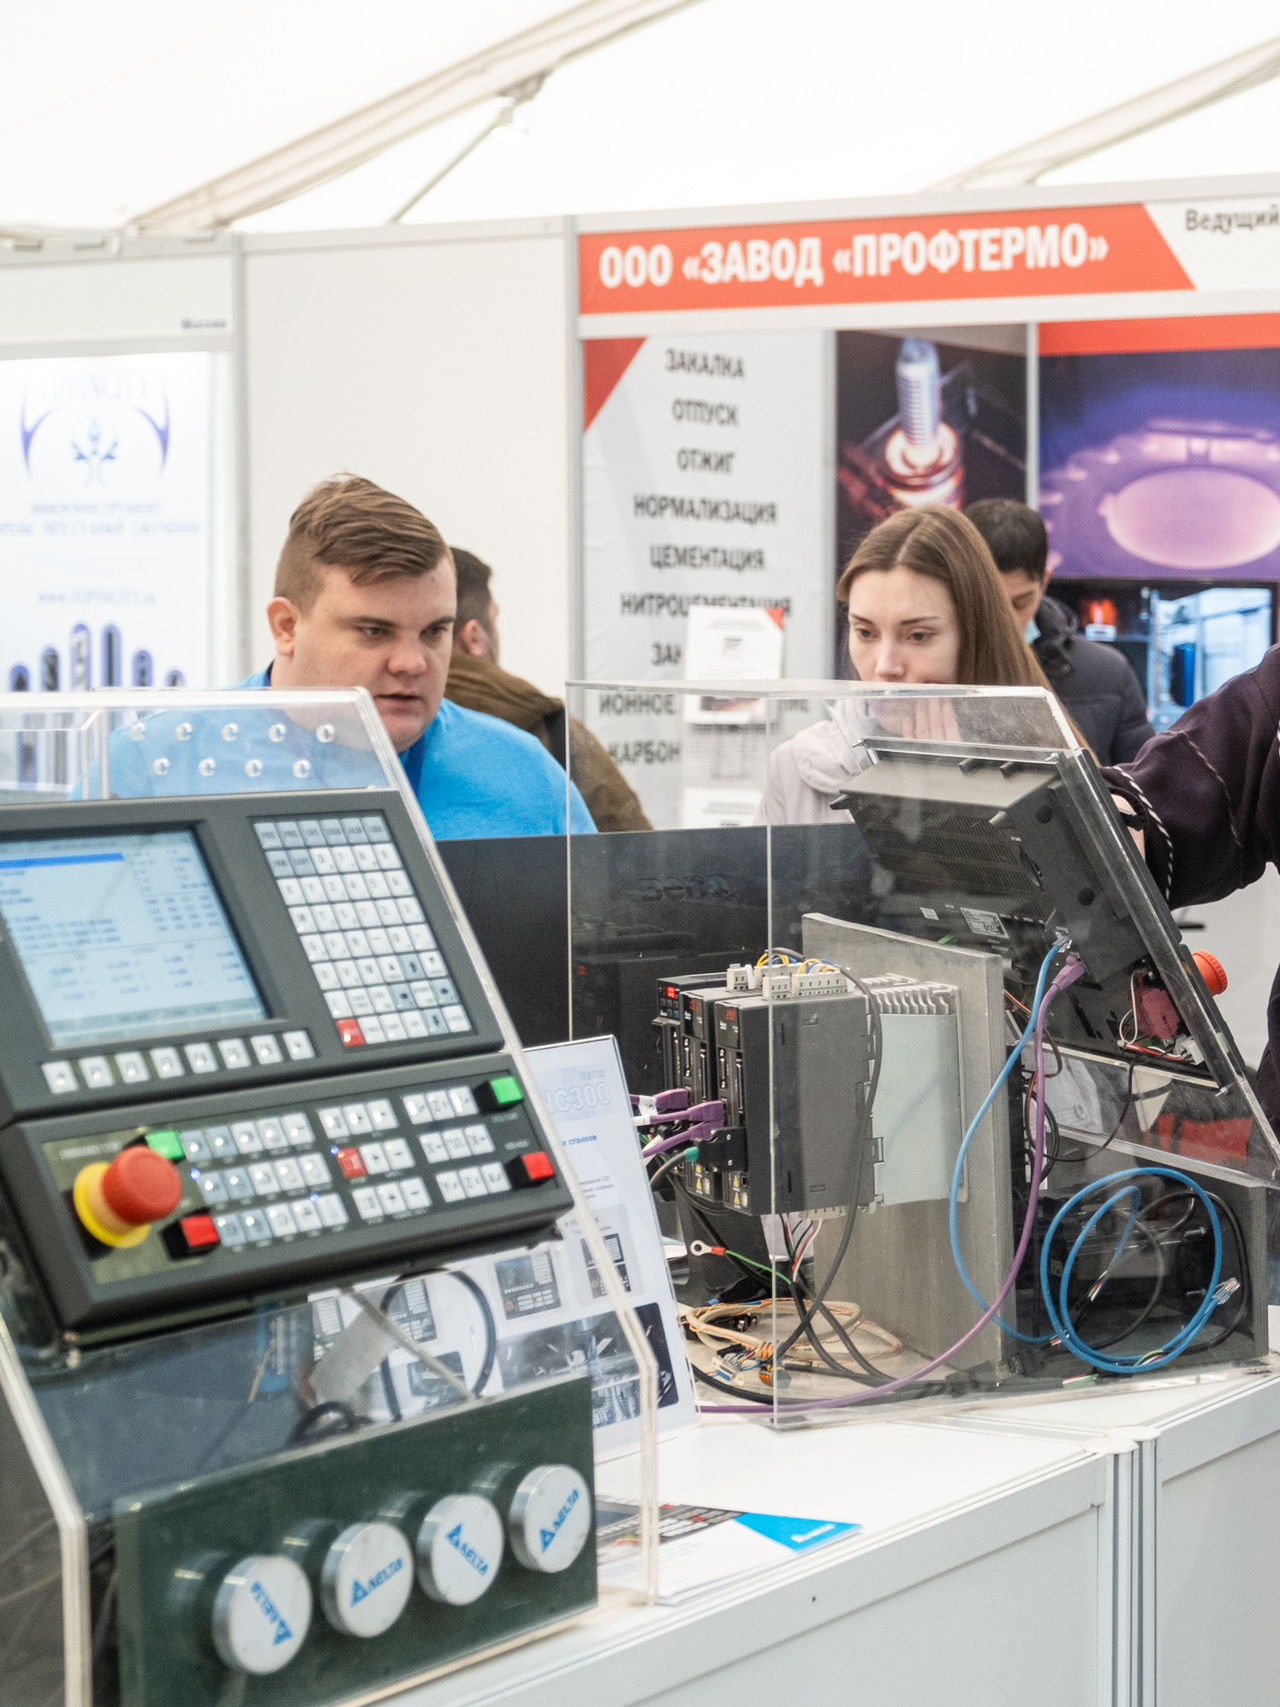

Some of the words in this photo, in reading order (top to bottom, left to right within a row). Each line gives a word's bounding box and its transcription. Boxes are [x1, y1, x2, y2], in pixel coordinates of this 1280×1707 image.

[1185, 203, 1280, 234] Ведущий
[599, 244, 673, 289] ООО
[682, 236, 824, 288] «ЗАВОД
[833, 222, 1109, 278] «ПРОФТЕРМО»
[665, 347, 745, 380] ЗАКАЛКА
[672, 398, 738, 428] ОТПУСК
[676, 447, 735, 474] ОТЖИГ
[633, 494, 777, 526] НОРМАЛИЗАЦИЯ
[650, 543, 765, 573] ЦЕМЕНТАЦИЯ
